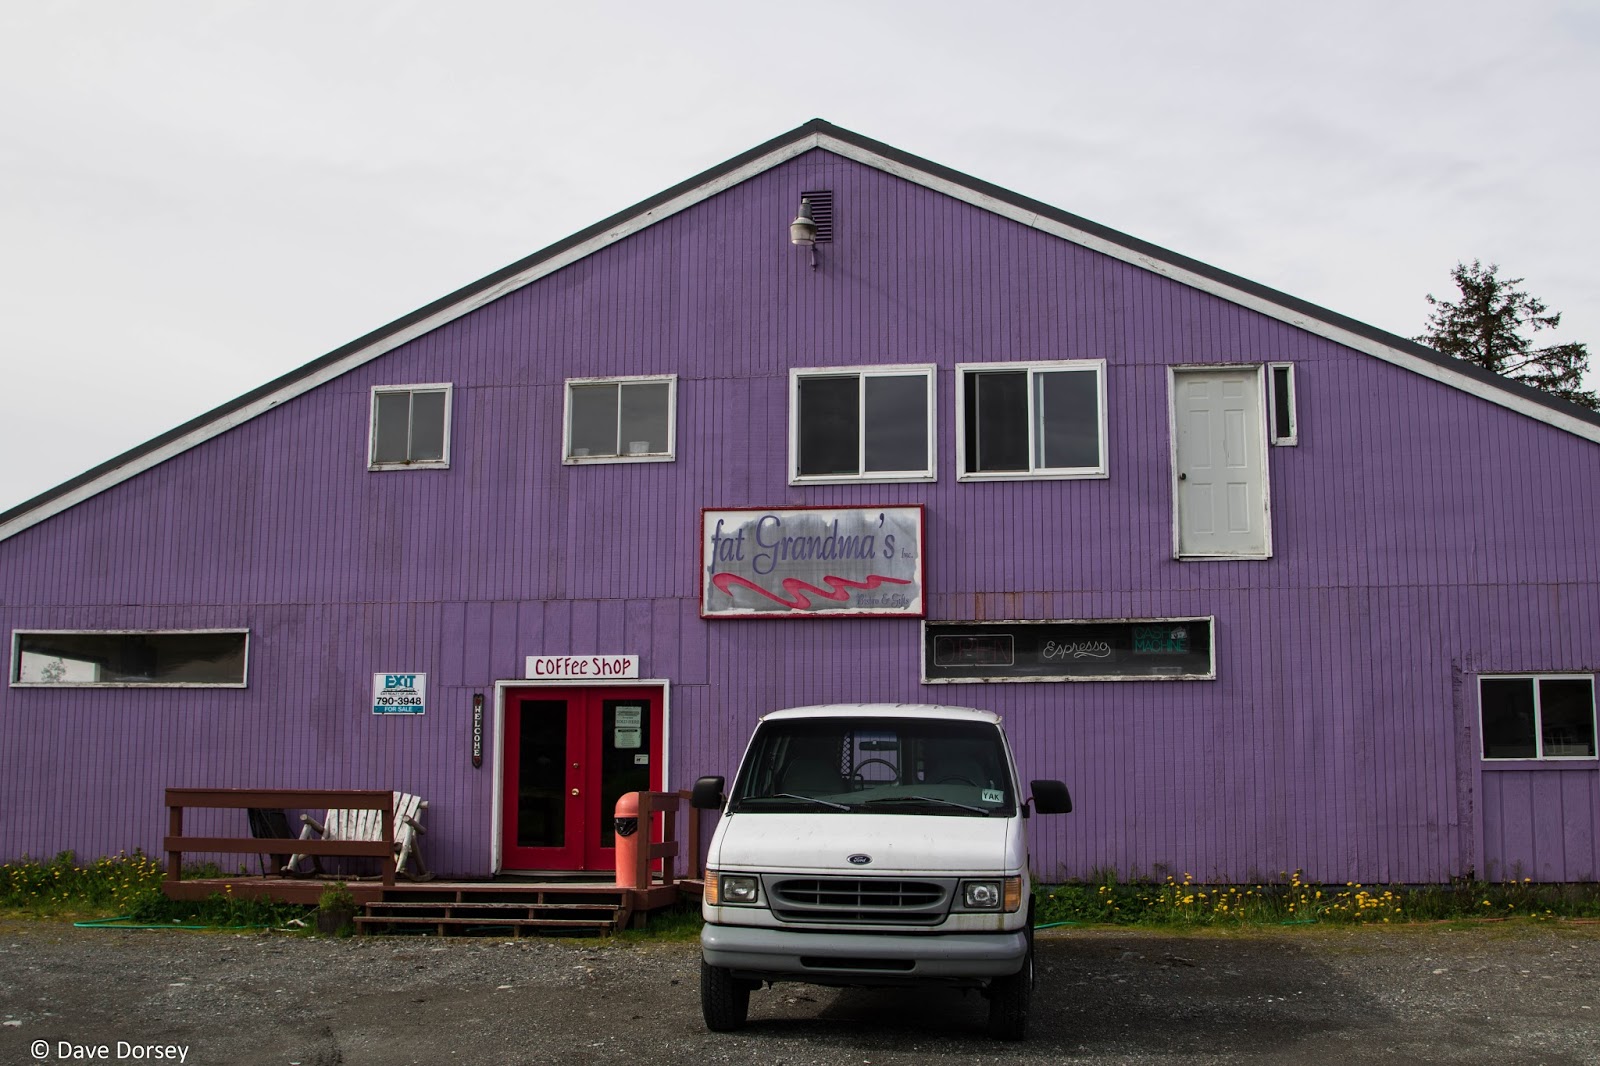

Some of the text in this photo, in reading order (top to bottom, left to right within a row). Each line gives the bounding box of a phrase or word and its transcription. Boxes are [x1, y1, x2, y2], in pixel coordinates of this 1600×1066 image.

[711, 518, 745, 574] fat
[752, 512, 895, 575] Grandma's
[1135, 627, 1171, 639] CASH
[937, 637, 1011, 663] OPEN
[1042, 640, 1111, 659] Espresso
[1135, 639, 1187, 653] MACHINE
[376, 697, 422, 705] 790-3948
[473, 705, 481, 757] WELCOME
[983, 792, 1000, 801] YAK
